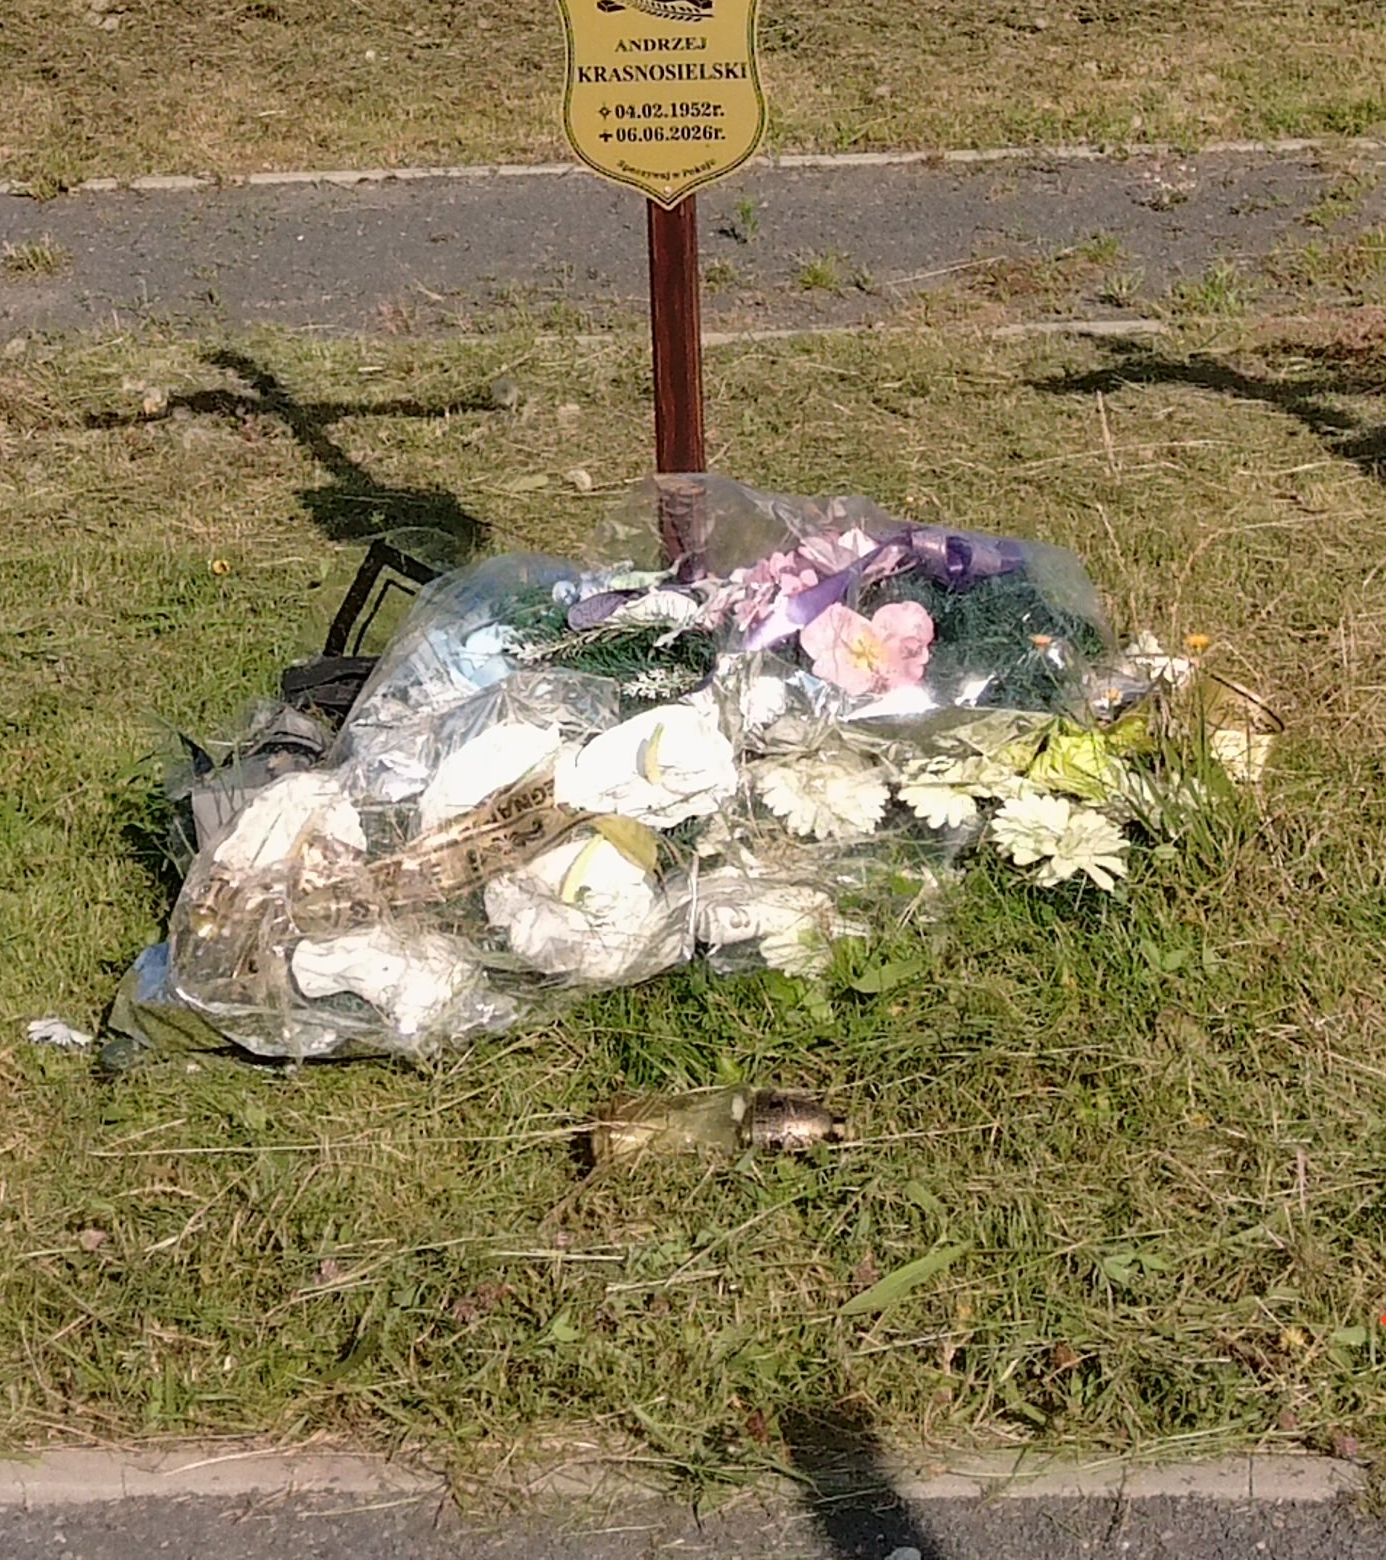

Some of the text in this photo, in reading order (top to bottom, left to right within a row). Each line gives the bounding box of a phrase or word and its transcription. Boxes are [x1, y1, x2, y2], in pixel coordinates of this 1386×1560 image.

[614, 37, 708, 53] ANDRZEJ
[577, 62, 749, 83] KRASNOSIELSKI
[615, 101, 725, 119] 04.02.1952r.
[616, 124, 726, 142] 06.06.2026r.
